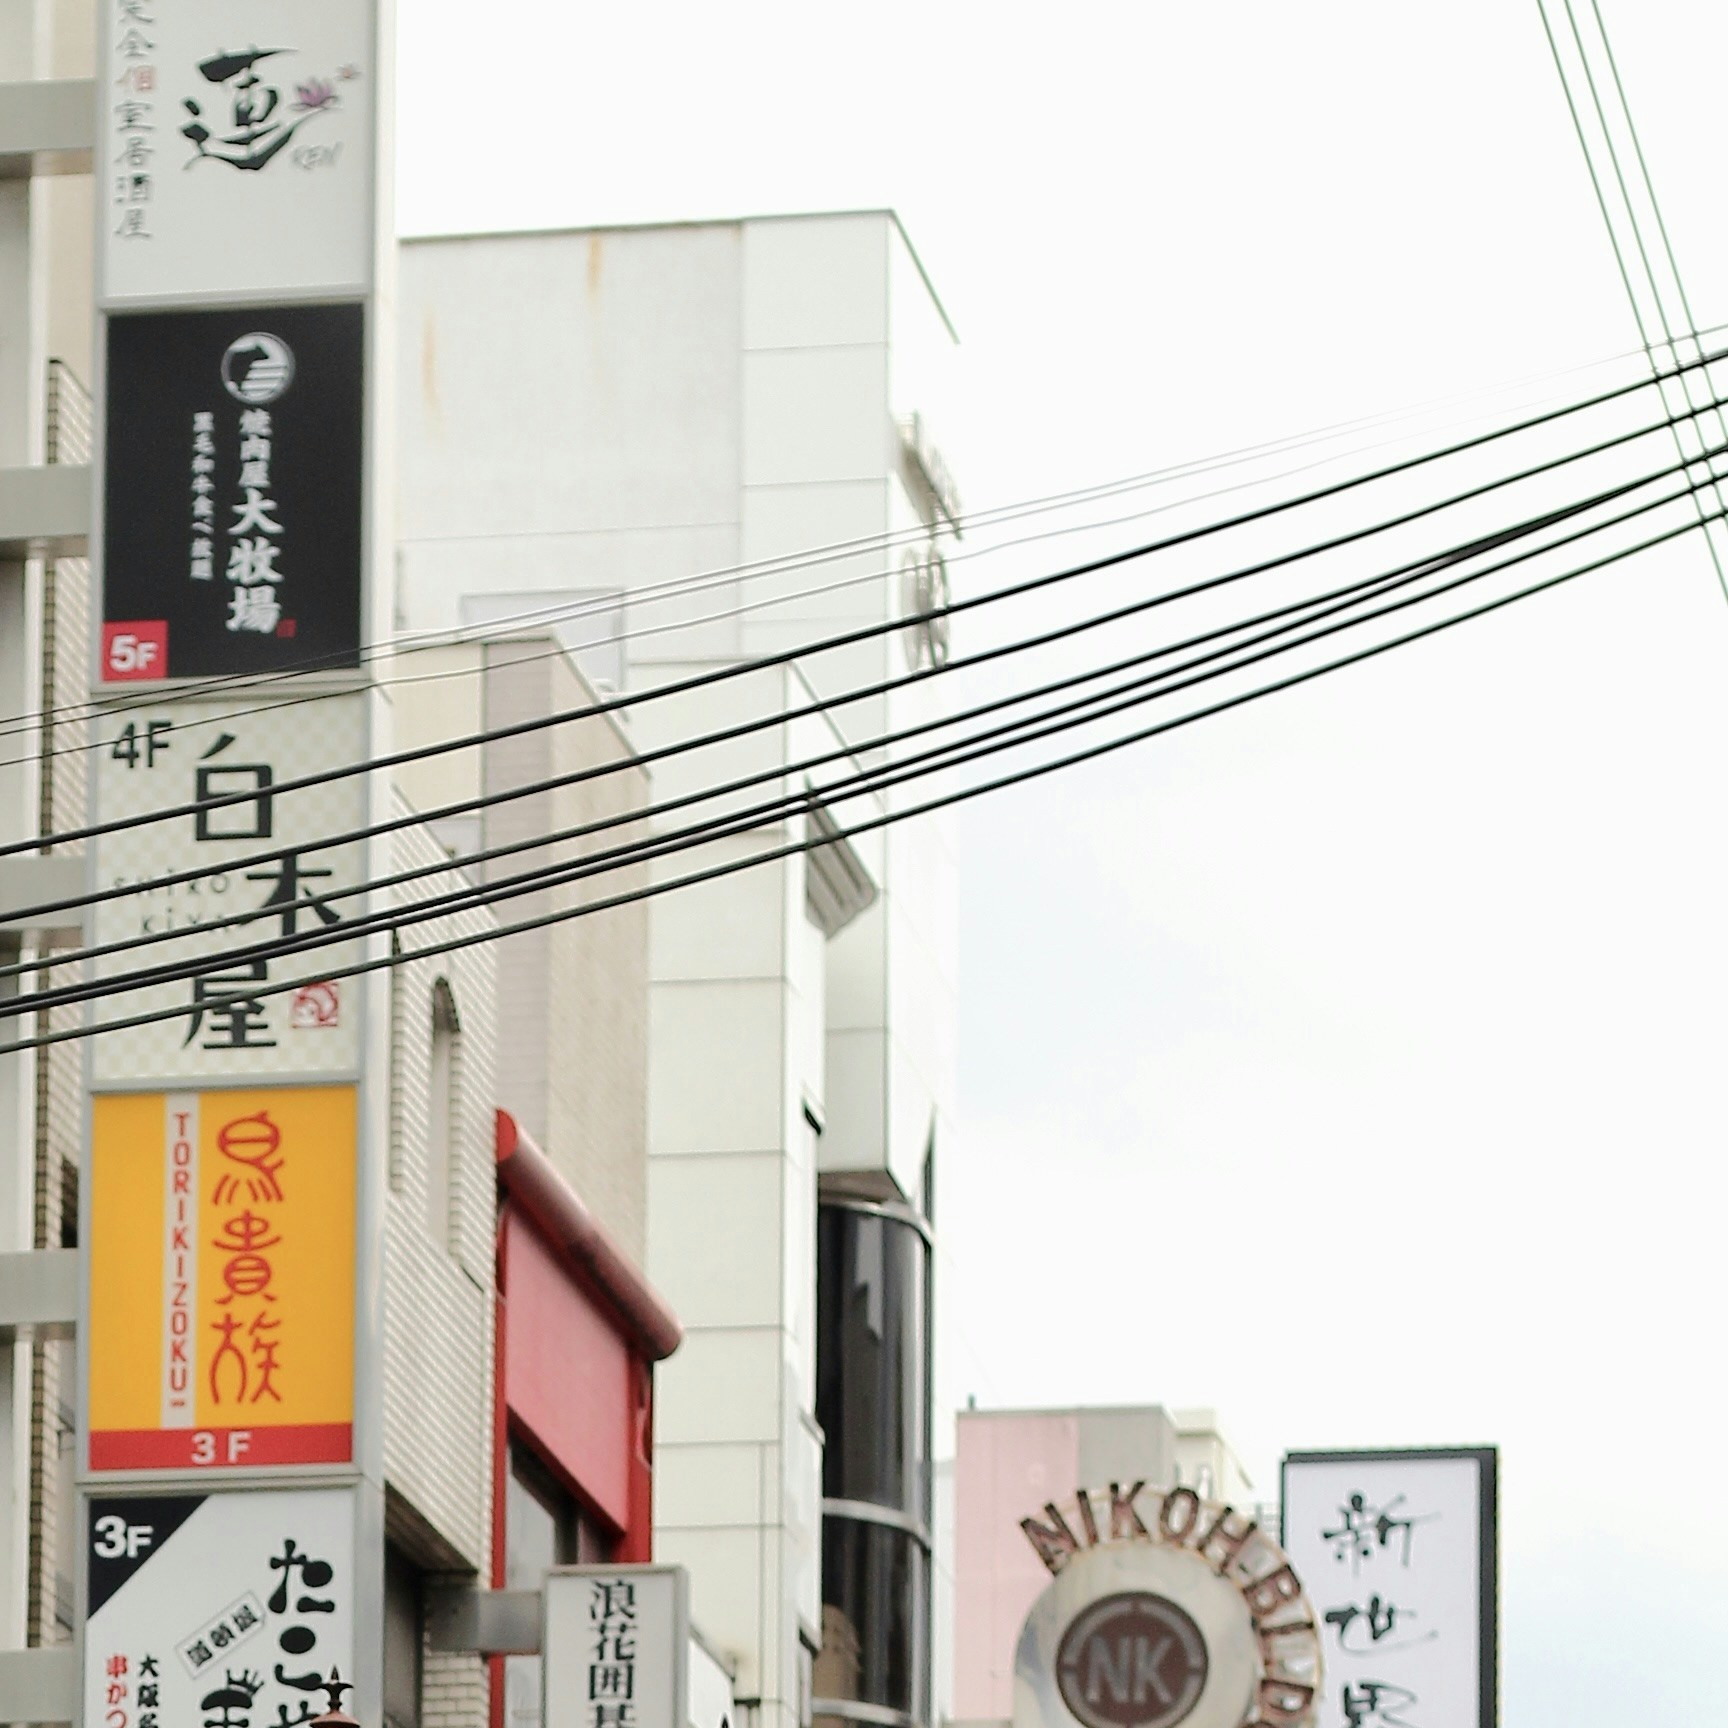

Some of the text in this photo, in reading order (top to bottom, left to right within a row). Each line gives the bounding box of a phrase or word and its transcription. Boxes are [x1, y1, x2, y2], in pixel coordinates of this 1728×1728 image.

[110, 634, 158, 672] 5F
[111, 721, 171, 769] 4F
[183, 734, 340, 1050] 白木屋
[191, 1432, 252, 1465] 3F
[94, 1515, 153, 1559] 3F
